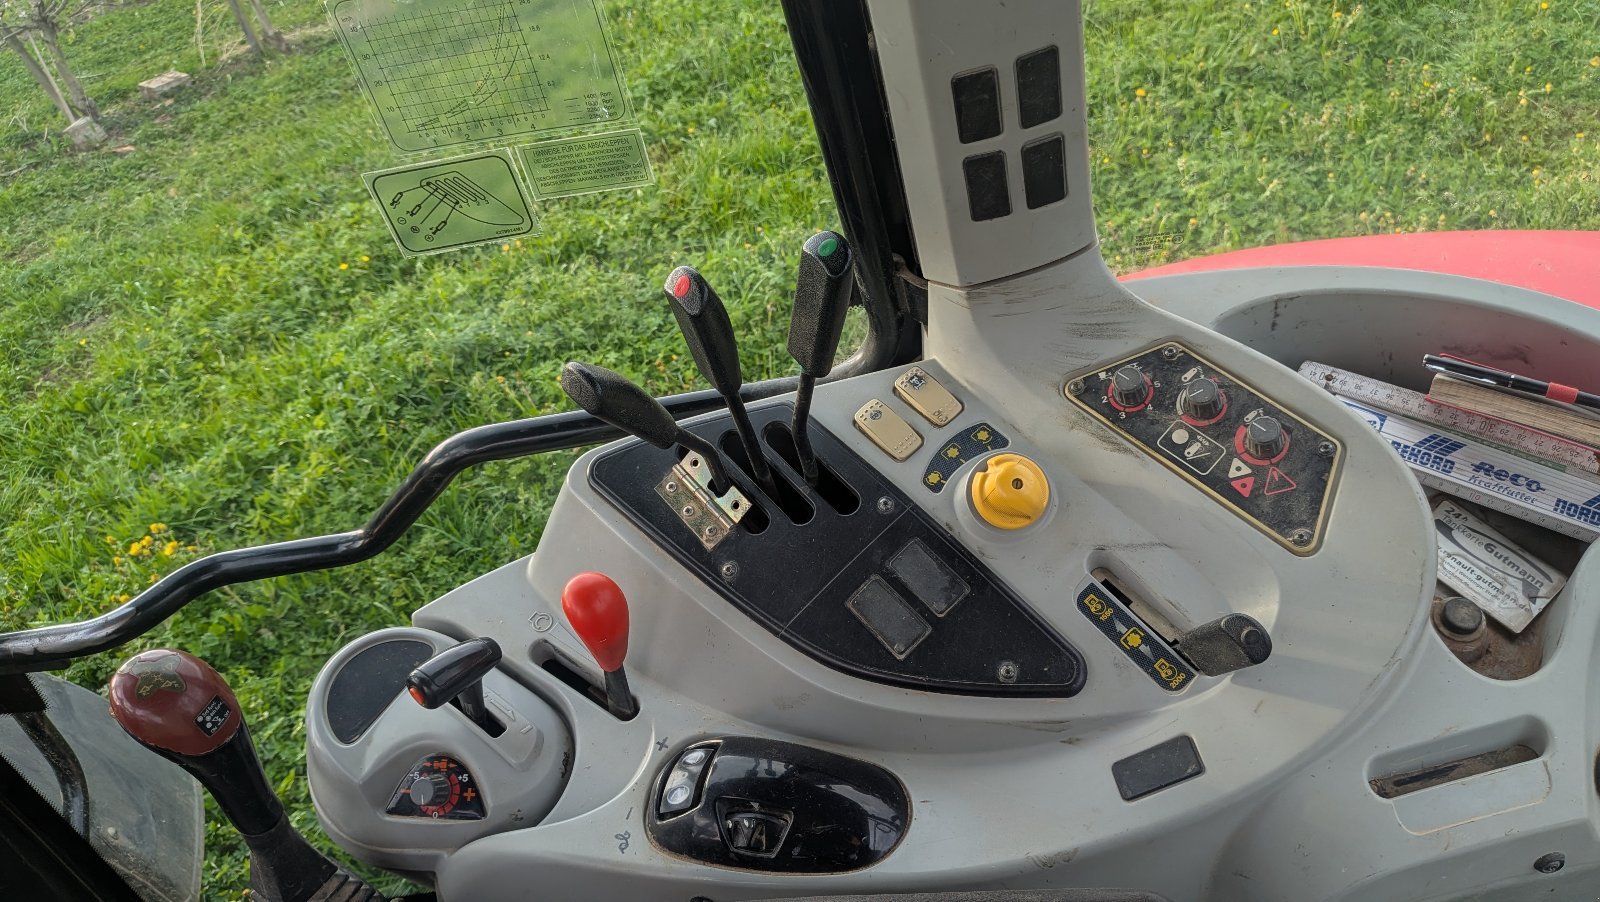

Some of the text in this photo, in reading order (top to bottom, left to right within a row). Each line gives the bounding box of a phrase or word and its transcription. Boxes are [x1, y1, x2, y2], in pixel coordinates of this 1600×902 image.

[374, 79, 383, 87] 20
[562, 145, 573, 153] FÜR
[587, 138, 629, 149] ABSCHLEPPEN
[1516, 433, 1527, 442] 28
[1534, 439, 1544, 447] 27
[1551, 444, 1562, 453] 26
[1569, 450, 1580, 458] 25
[1468, 474, 1538, 504] Kraftfutter
[1442, 514, 1484, 547] Tankkarte
[1484, 543, 1545, 589] Gutmann
[1170, 672, 1186, 689] 2000
[458, 774, 468, 782] +5
